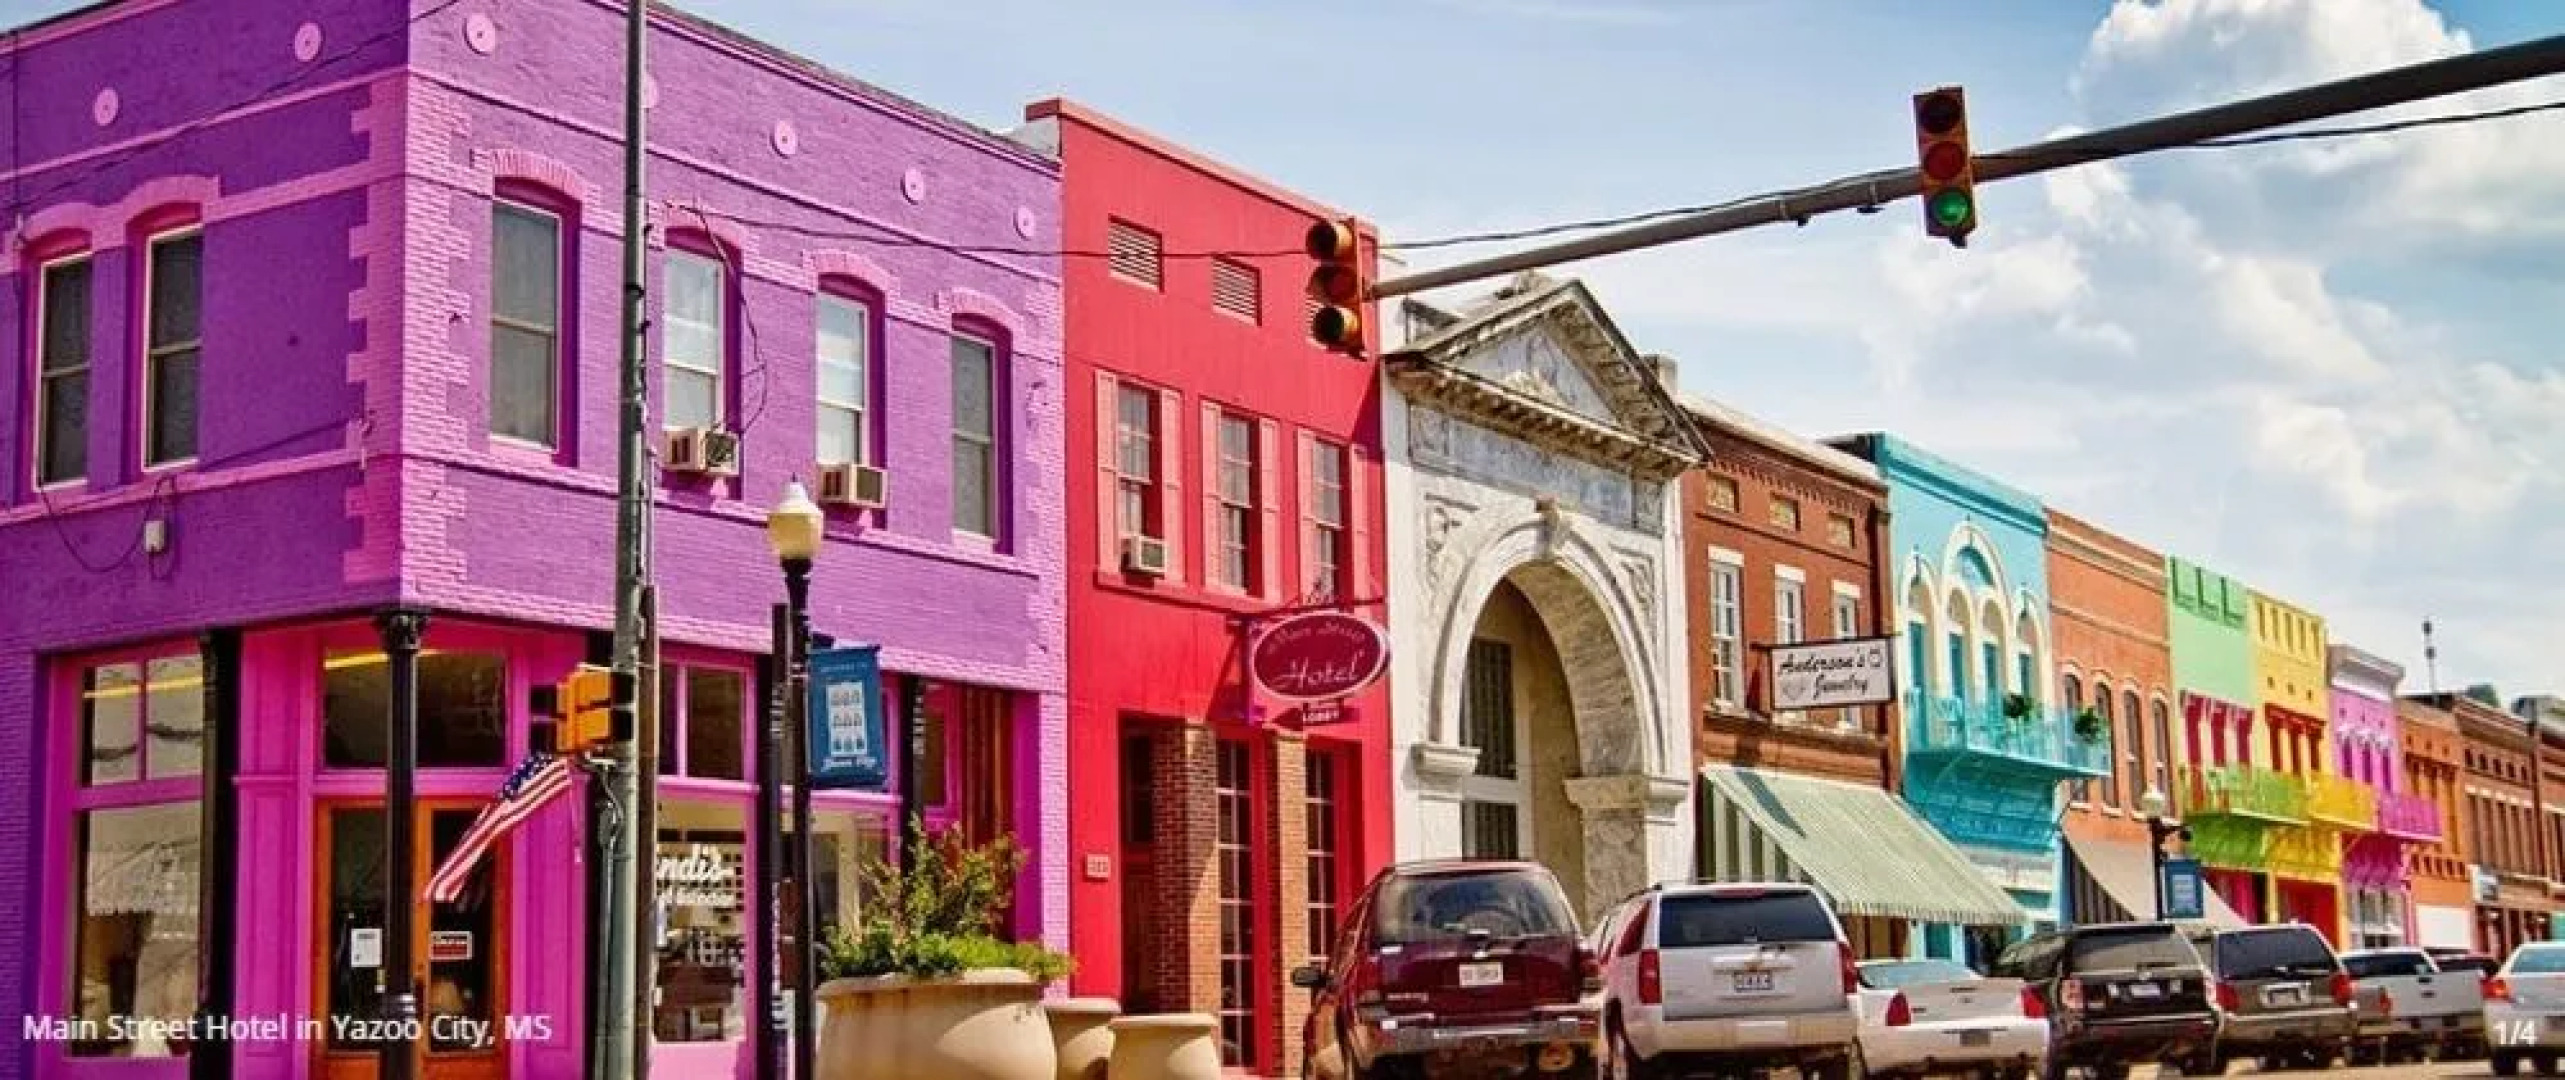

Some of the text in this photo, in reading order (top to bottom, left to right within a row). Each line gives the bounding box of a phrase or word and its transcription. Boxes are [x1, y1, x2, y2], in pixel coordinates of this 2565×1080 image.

[1270, 650, 1365, 689] Hotel
[1778, 645, 1866, 676] Anderson's
[1812, 673, 1868, 700] Jewelry
